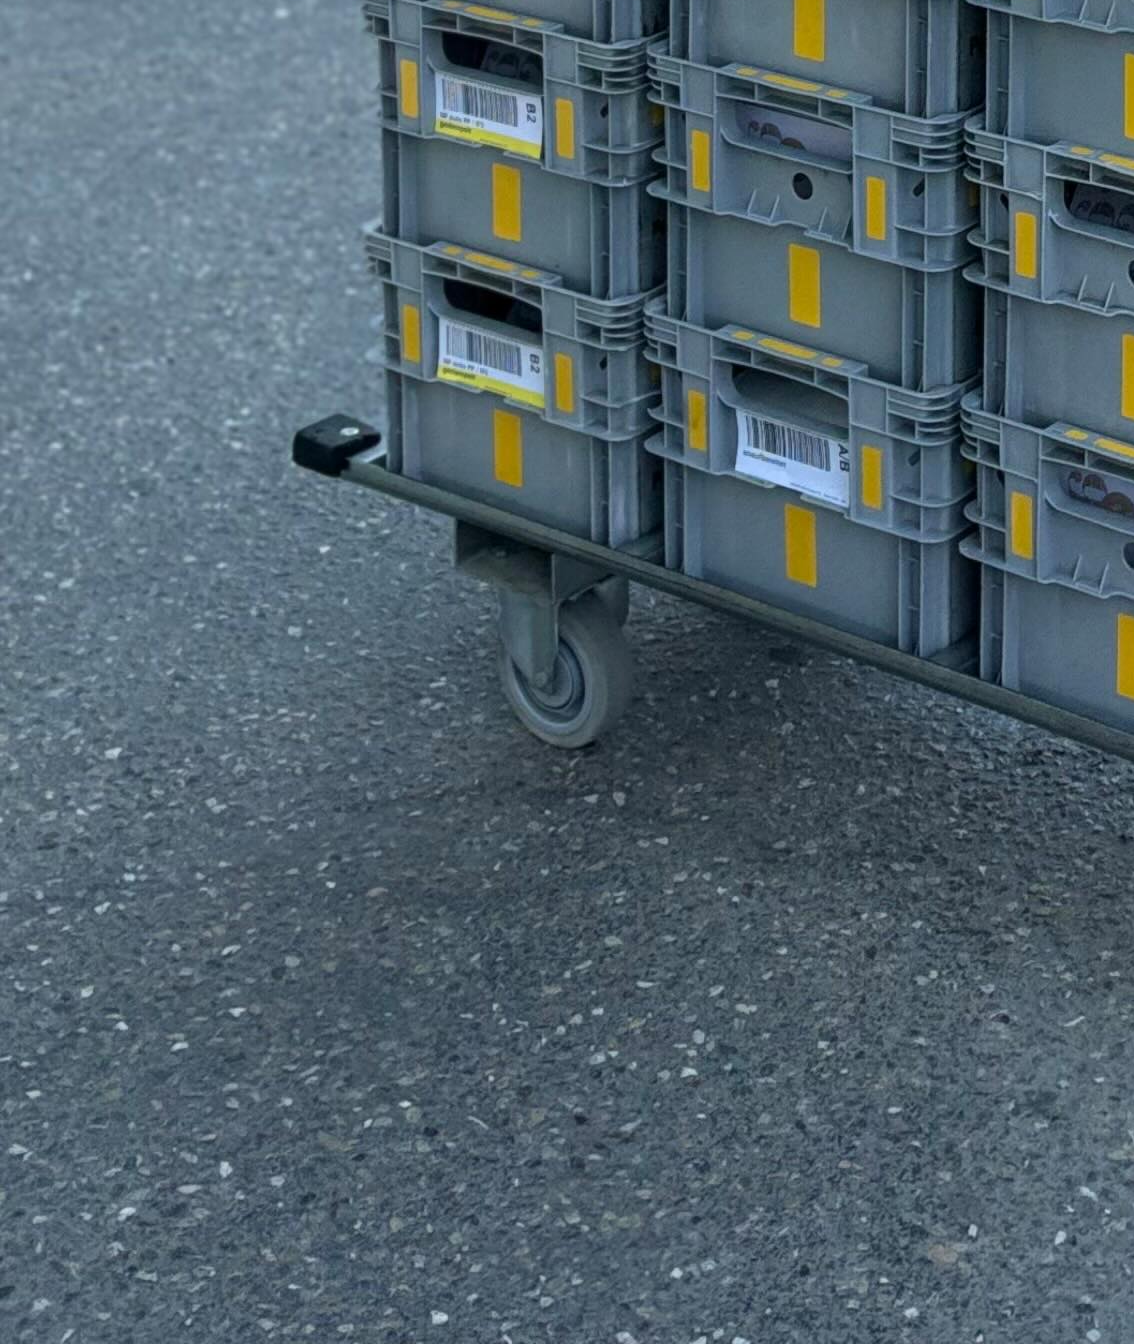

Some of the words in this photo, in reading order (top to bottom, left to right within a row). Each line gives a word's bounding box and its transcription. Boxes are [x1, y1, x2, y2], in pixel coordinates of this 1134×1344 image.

[526, 102, 537, 123] B2
[529, 353, 541, 374] B2
[838, 443, 850, 472] A/B
